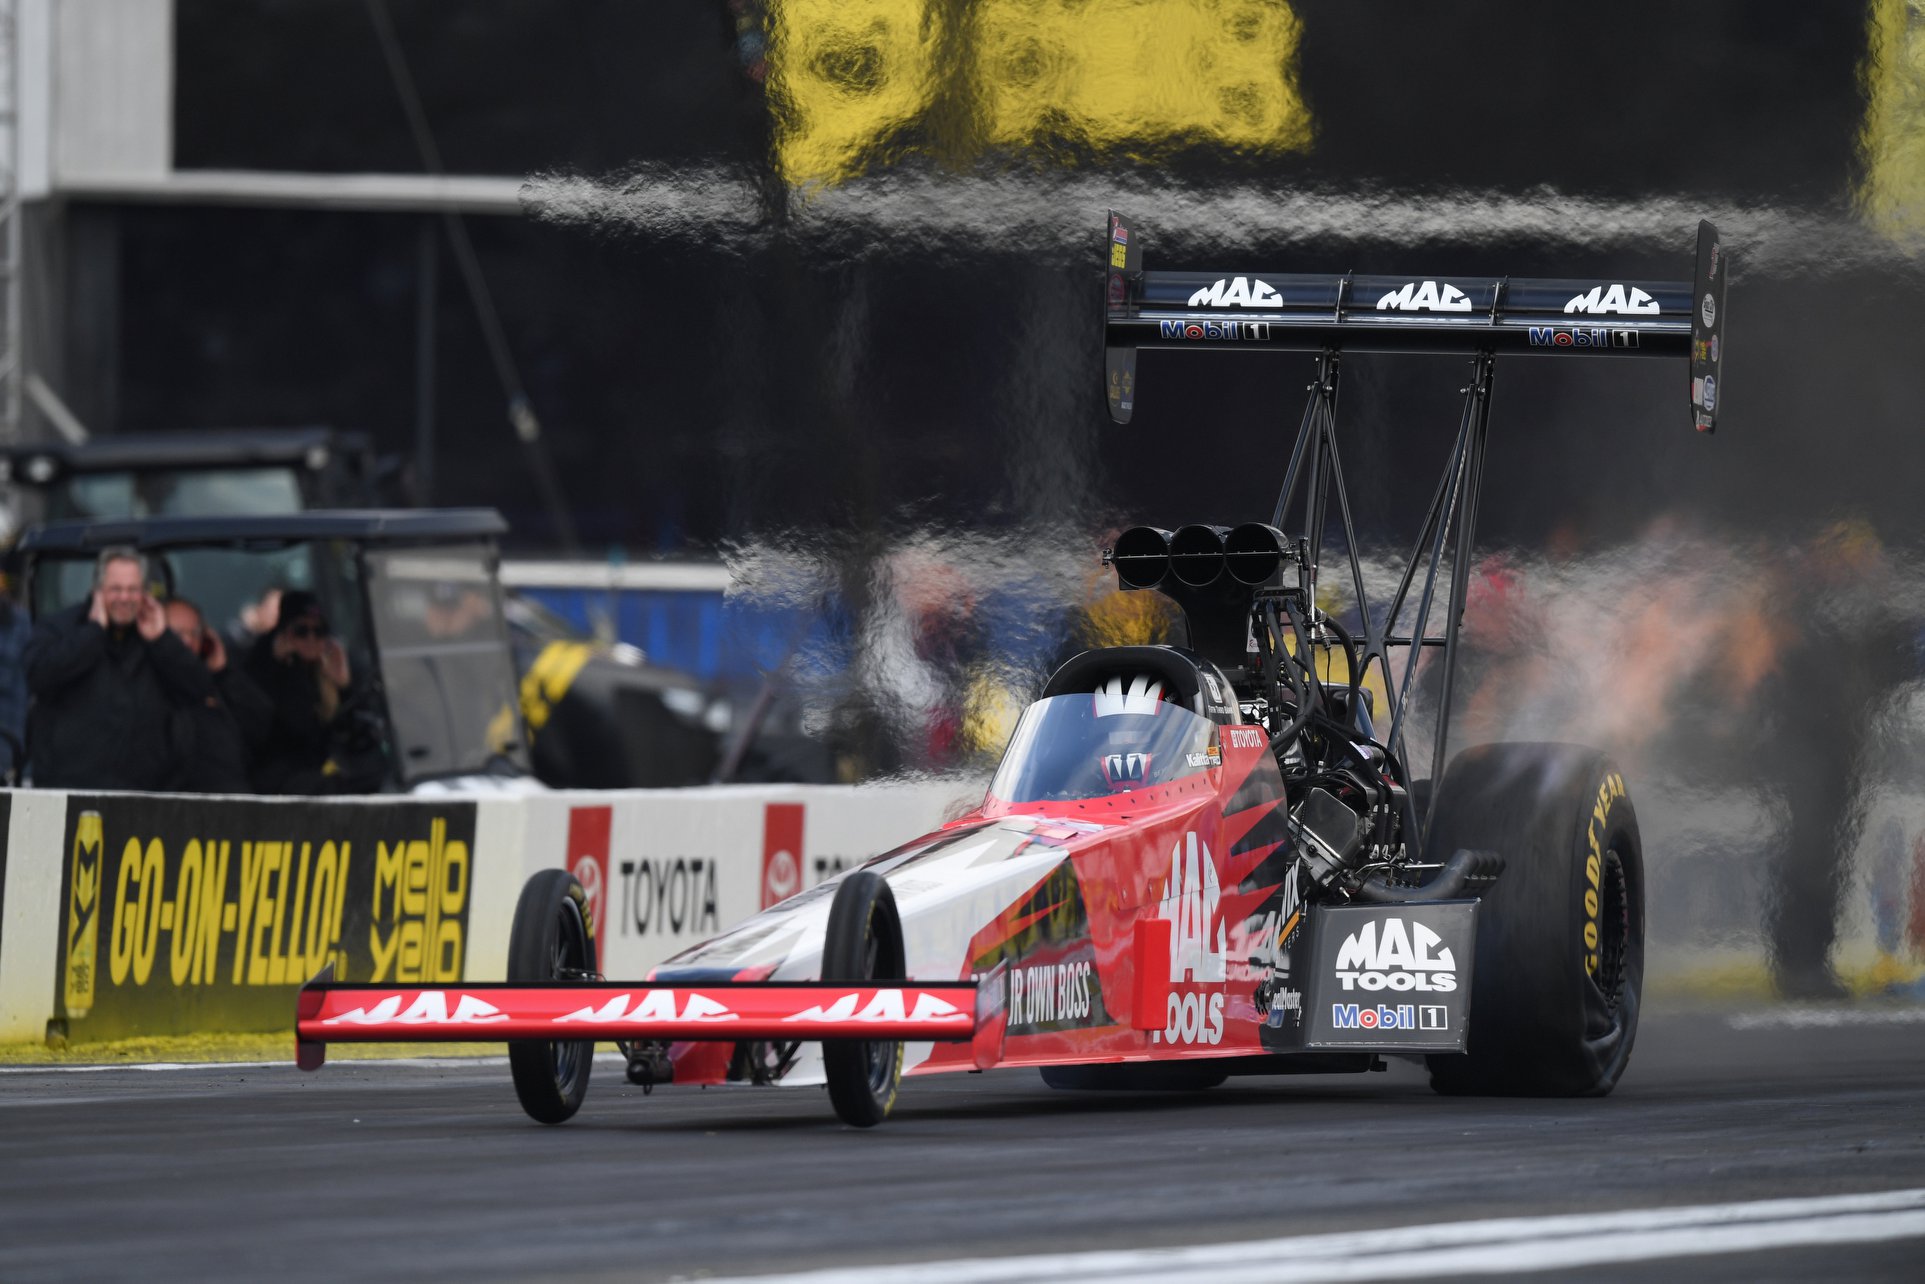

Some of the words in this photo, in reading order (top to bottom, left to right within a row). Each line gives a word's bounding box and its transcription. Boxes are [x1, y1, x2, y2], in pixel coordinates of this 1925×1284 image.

[1188, 277, 1283, 307] MAC
[1376, 281, 1472, 311] MAC
[1564, 284, 1660, 315] MAC
[1160, 320, 1238, 340] Mobil
[1529, 327, 1607, 347] Mobil
[1234, 730, 1263, 748] TOYOTA
[1186, 752, 1210, 767] Kalitta
[1584, 773, 1625, 976] GOODYEAR
[110, 837, 351, 985] GO-ON-YELLO!
[620, 857, 719, 935] TOYOTA
[1335, 918, 1456, 971] MAC
[1026, 964, 1055, 1024] OWN
[1057, 961, 1091, 1020] BOSS
[1335, 971, 1457, 992] TOOLS
[323, 991, 510, 1024] MAC
[552, 989, 740, 1023] MAC
[781, 989, 972, 1023] MAC
[1272, 987, 1302, 1010] ealMaster
[1153, 991, 1224, 1045] OOLS
[1332, 1003, 1415, 1029] Mobil
